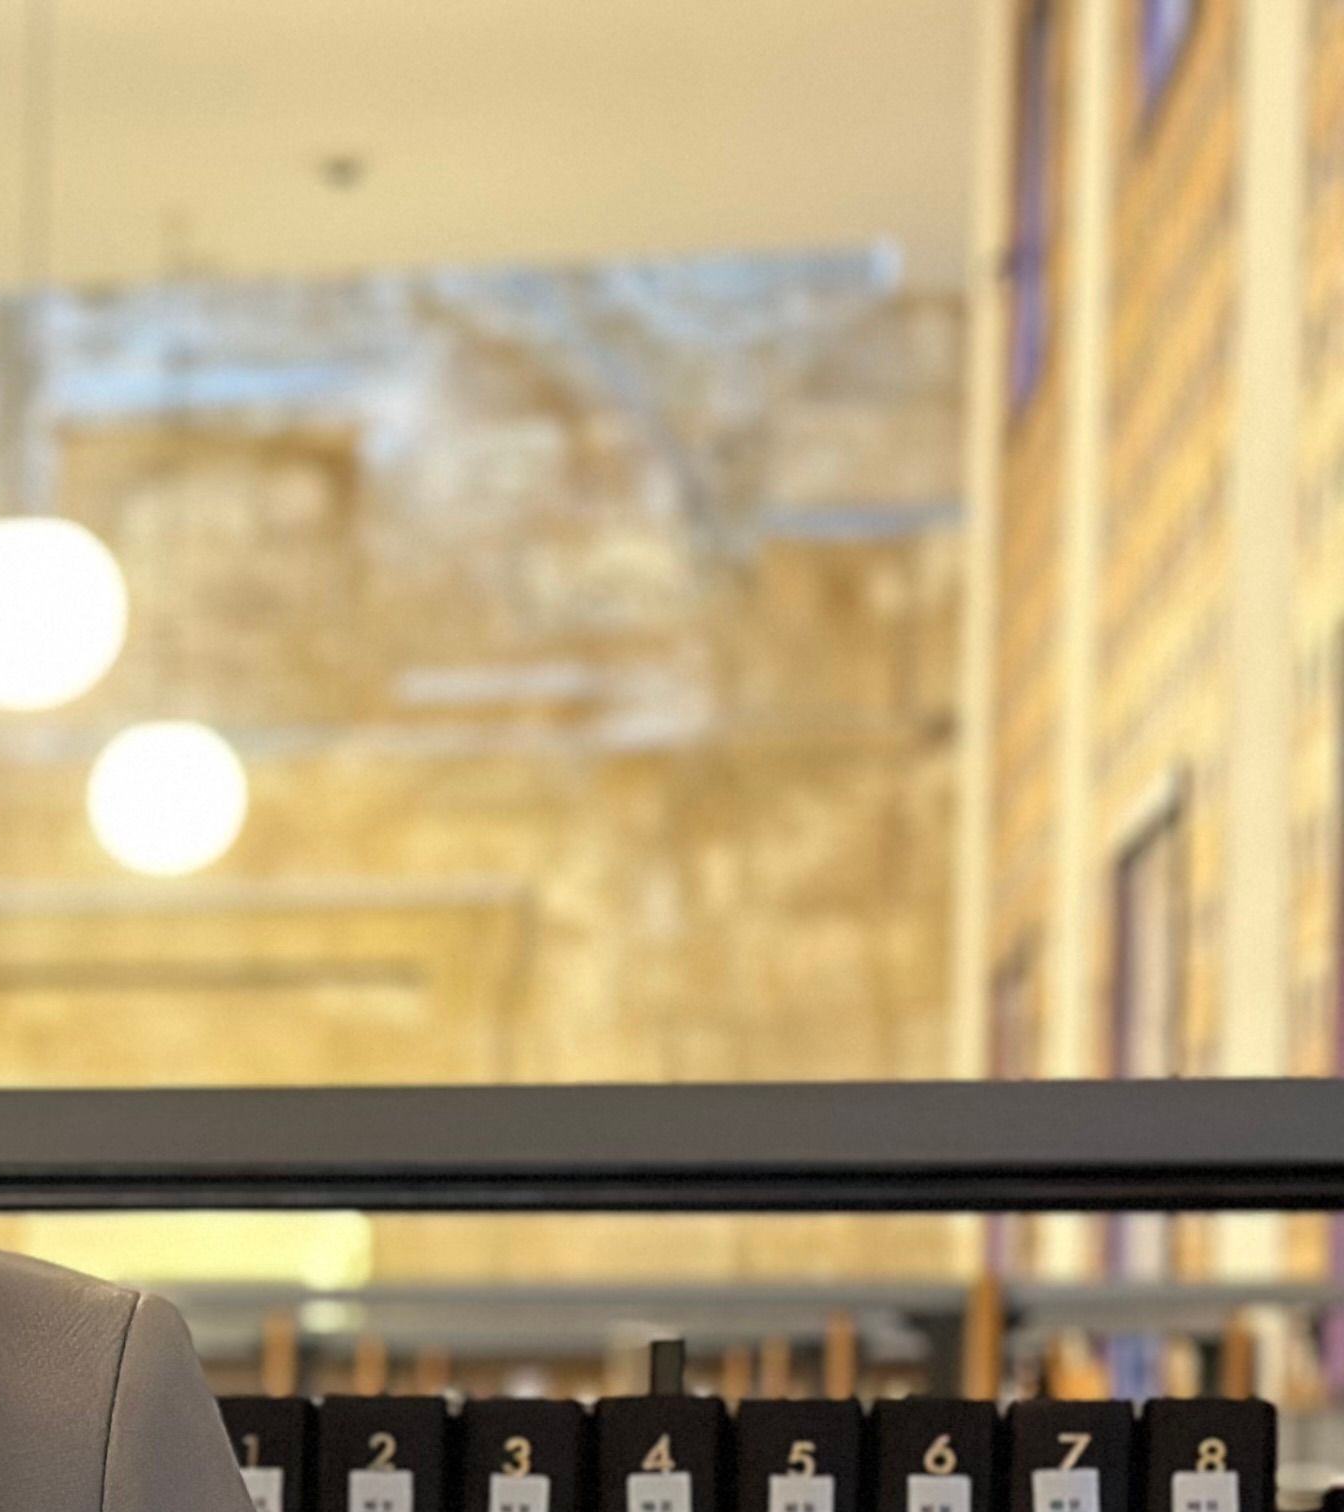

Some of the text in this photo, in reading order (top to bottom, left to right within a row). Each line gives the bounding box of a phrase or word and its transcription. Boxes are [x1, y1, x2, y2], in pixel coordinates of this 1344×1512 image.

[244, 1434, 262, 1467] 1
[369, 1432, 398, 1470] 2
[503, 1436, 532, 1478] 3
[642, 1434, 677, 1474] 4
[787, 1442, 816, 1477] 5
[924, 1434, 957, 1475] 6
[1057, 1433, 1092, 1470] 7
[1196, 1438, 1228, 1473] 8
